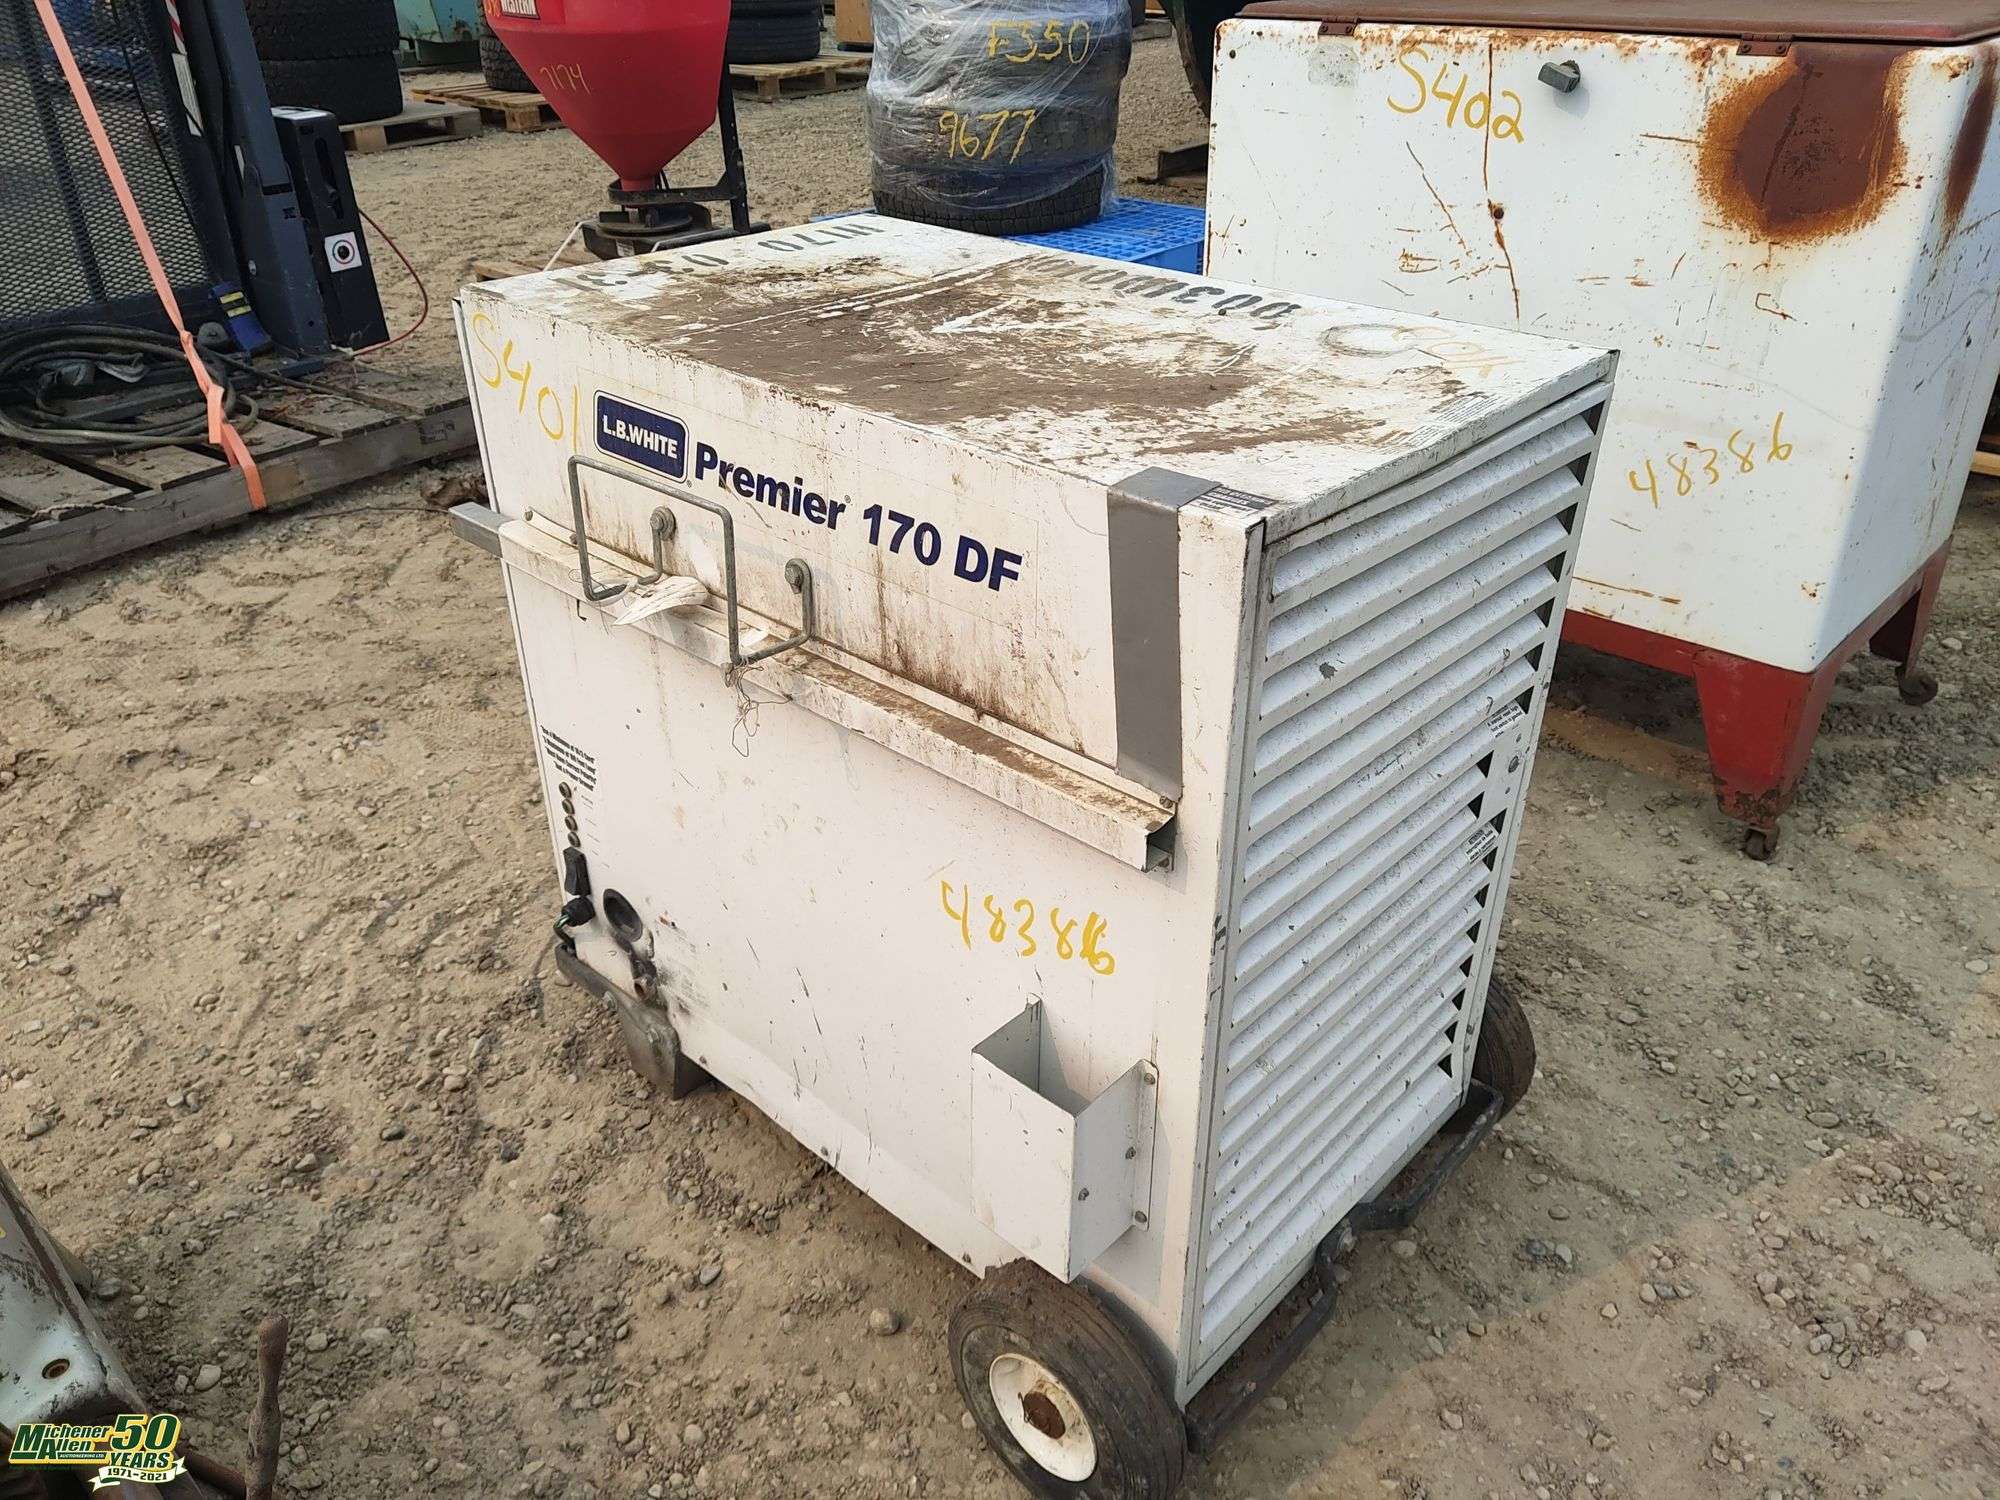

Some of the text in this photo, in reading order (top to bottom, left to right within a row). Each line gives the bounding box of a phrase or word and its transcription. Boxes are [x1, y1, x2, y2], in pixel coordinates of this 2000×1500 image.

[987, 20, 1091, 65] F350
[939, 108, 1037, 165] 9677
[1386, 47, 1526, 144] S402
[472, 312, 580, 452] S401
[1628, 411, 1793, 509] 48386
[695, 441, 1023, 592] Premier 170 DF
